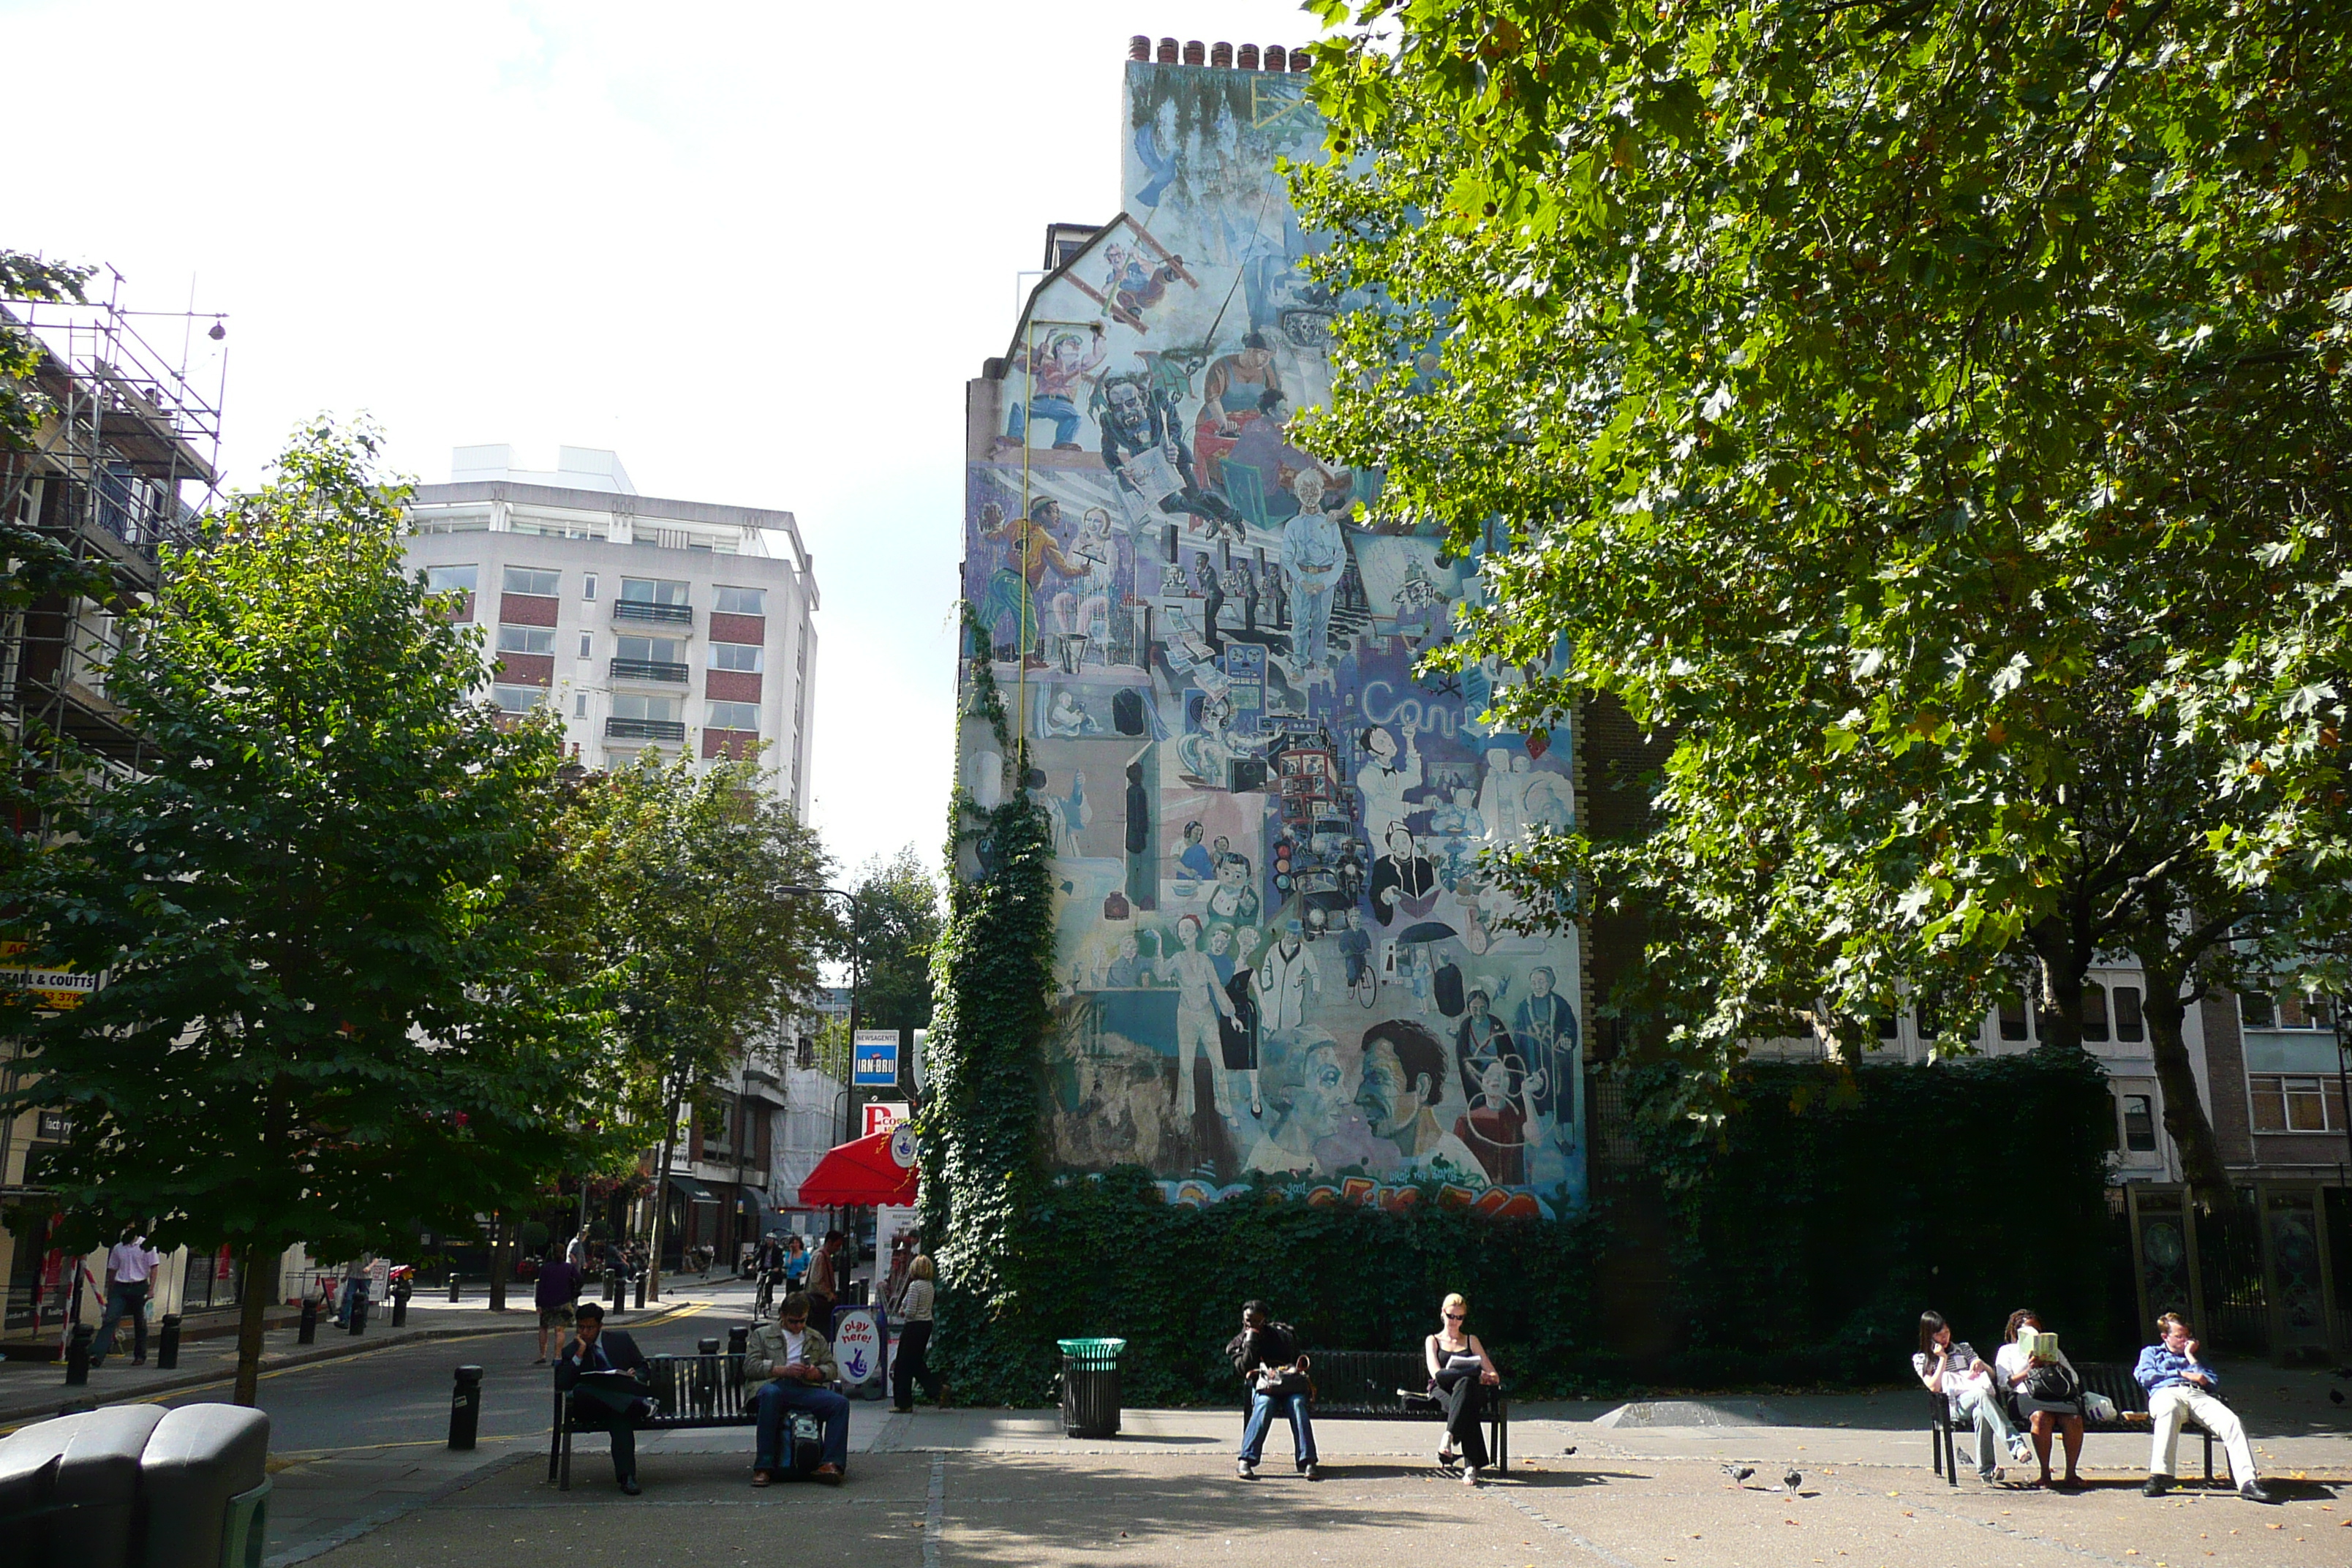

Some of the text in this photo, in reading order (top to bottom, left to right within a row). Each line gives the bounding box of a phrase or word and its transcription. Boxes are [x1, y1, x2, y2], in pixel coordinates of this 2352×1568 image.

[37, 975, 45, 984] &
[49, 975, 94, 987] COUTTS
[844, 1319, 870, 1333] play
[841, 1333, 872, 1344] here!
